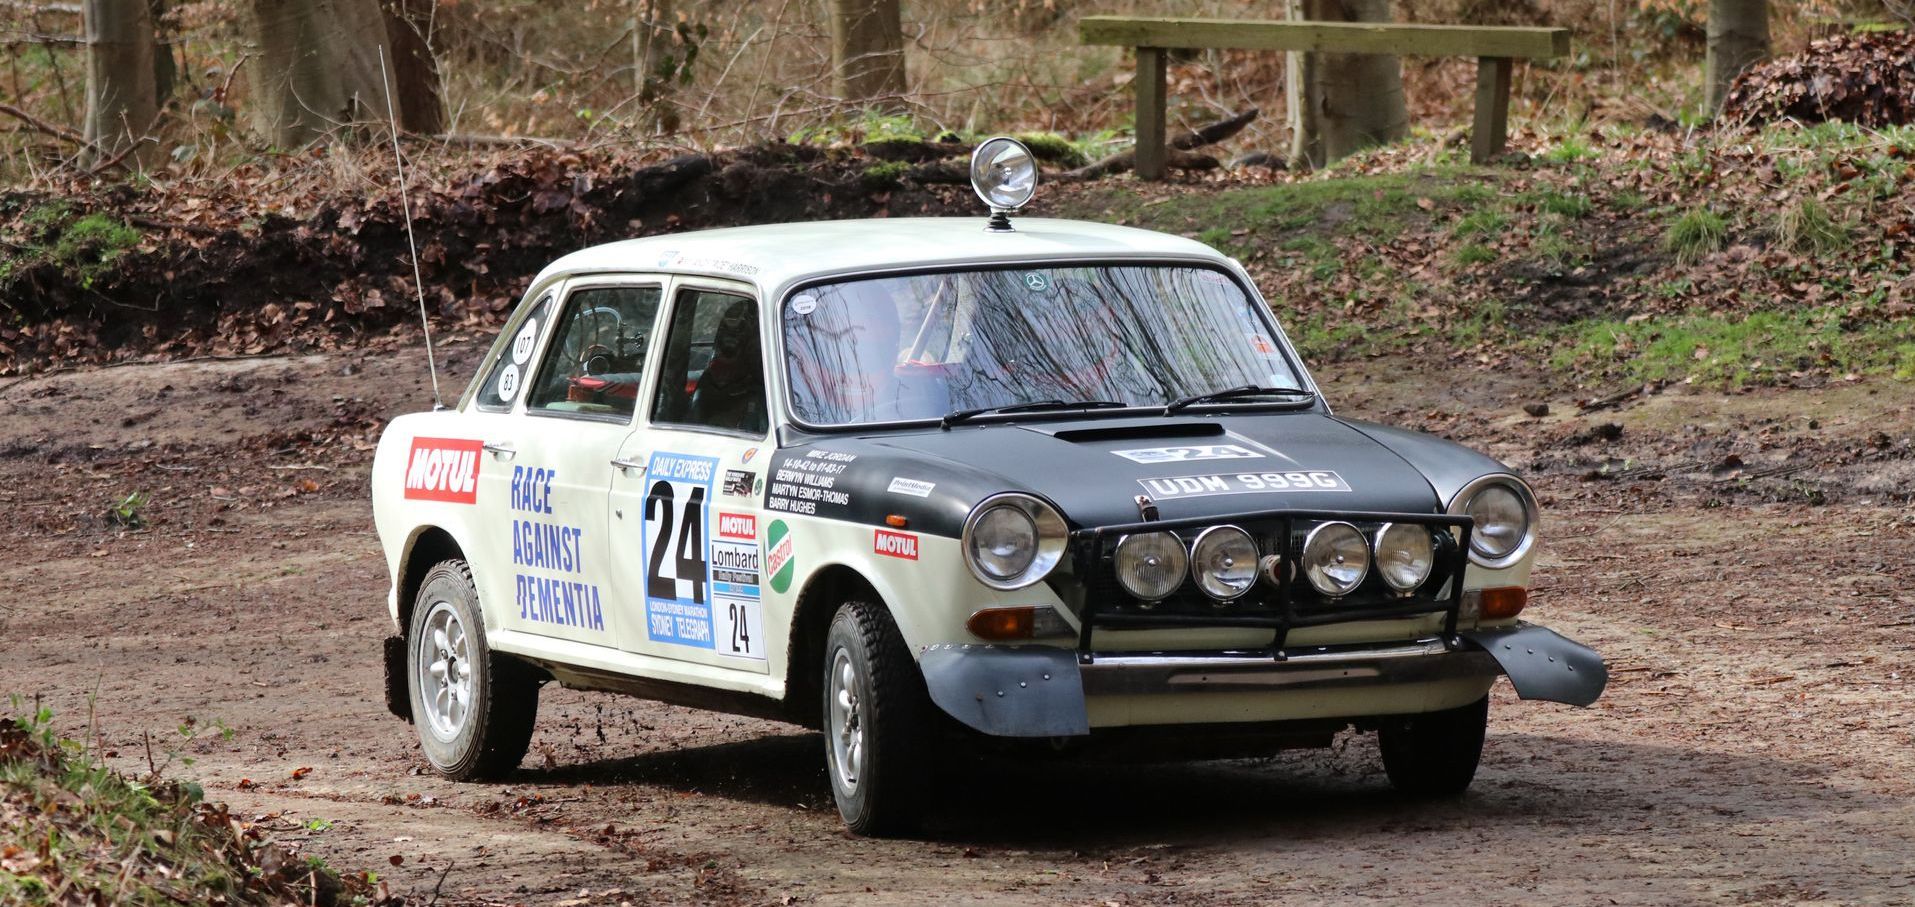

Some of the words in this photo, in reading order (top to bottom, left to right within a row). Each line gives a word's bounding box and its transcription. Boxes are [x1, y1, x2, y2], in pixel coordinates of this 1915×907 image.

[516, 336, 531, 354] 107
[504, 374, 514, 391] 83
[406, 448, 477, 493] MOTUL
[651, 457, 676, 476] DAILY
[674, 459, 713, 481] EXPRESS
[775, 469, 805, 484] BERWYN
[803, 473, 834, 488] WILLIAMS
[511, 465, 555, 514] RACE
[771, 483, 799, 497] MARTYN
[798, 486, 849, 505] ESMOR-THOMAS
[1149, 478, 1230, 496] UDM
[1236, 471, 1338, 490] 999G
[769, 497, 789, 511] BARRY
[789, 500, 816, 514] HUGHES
[721, 516, 755, 535] MOTUL
[513, 520, 581, 573] AGAINST
[645, 480, 707, 605] 24
[876, 533, 917, 557] MOTUL
[711, 545, 759, 569] Lombard
[768, 534, 793, 577] Castrol
[516, 574, 604, 631] DEMENTIA
[651, 612, 674, 637] SYDNEY
[676, 616, 710, 642] TELEGRAPH
[729, 603, 750, 653] 24
